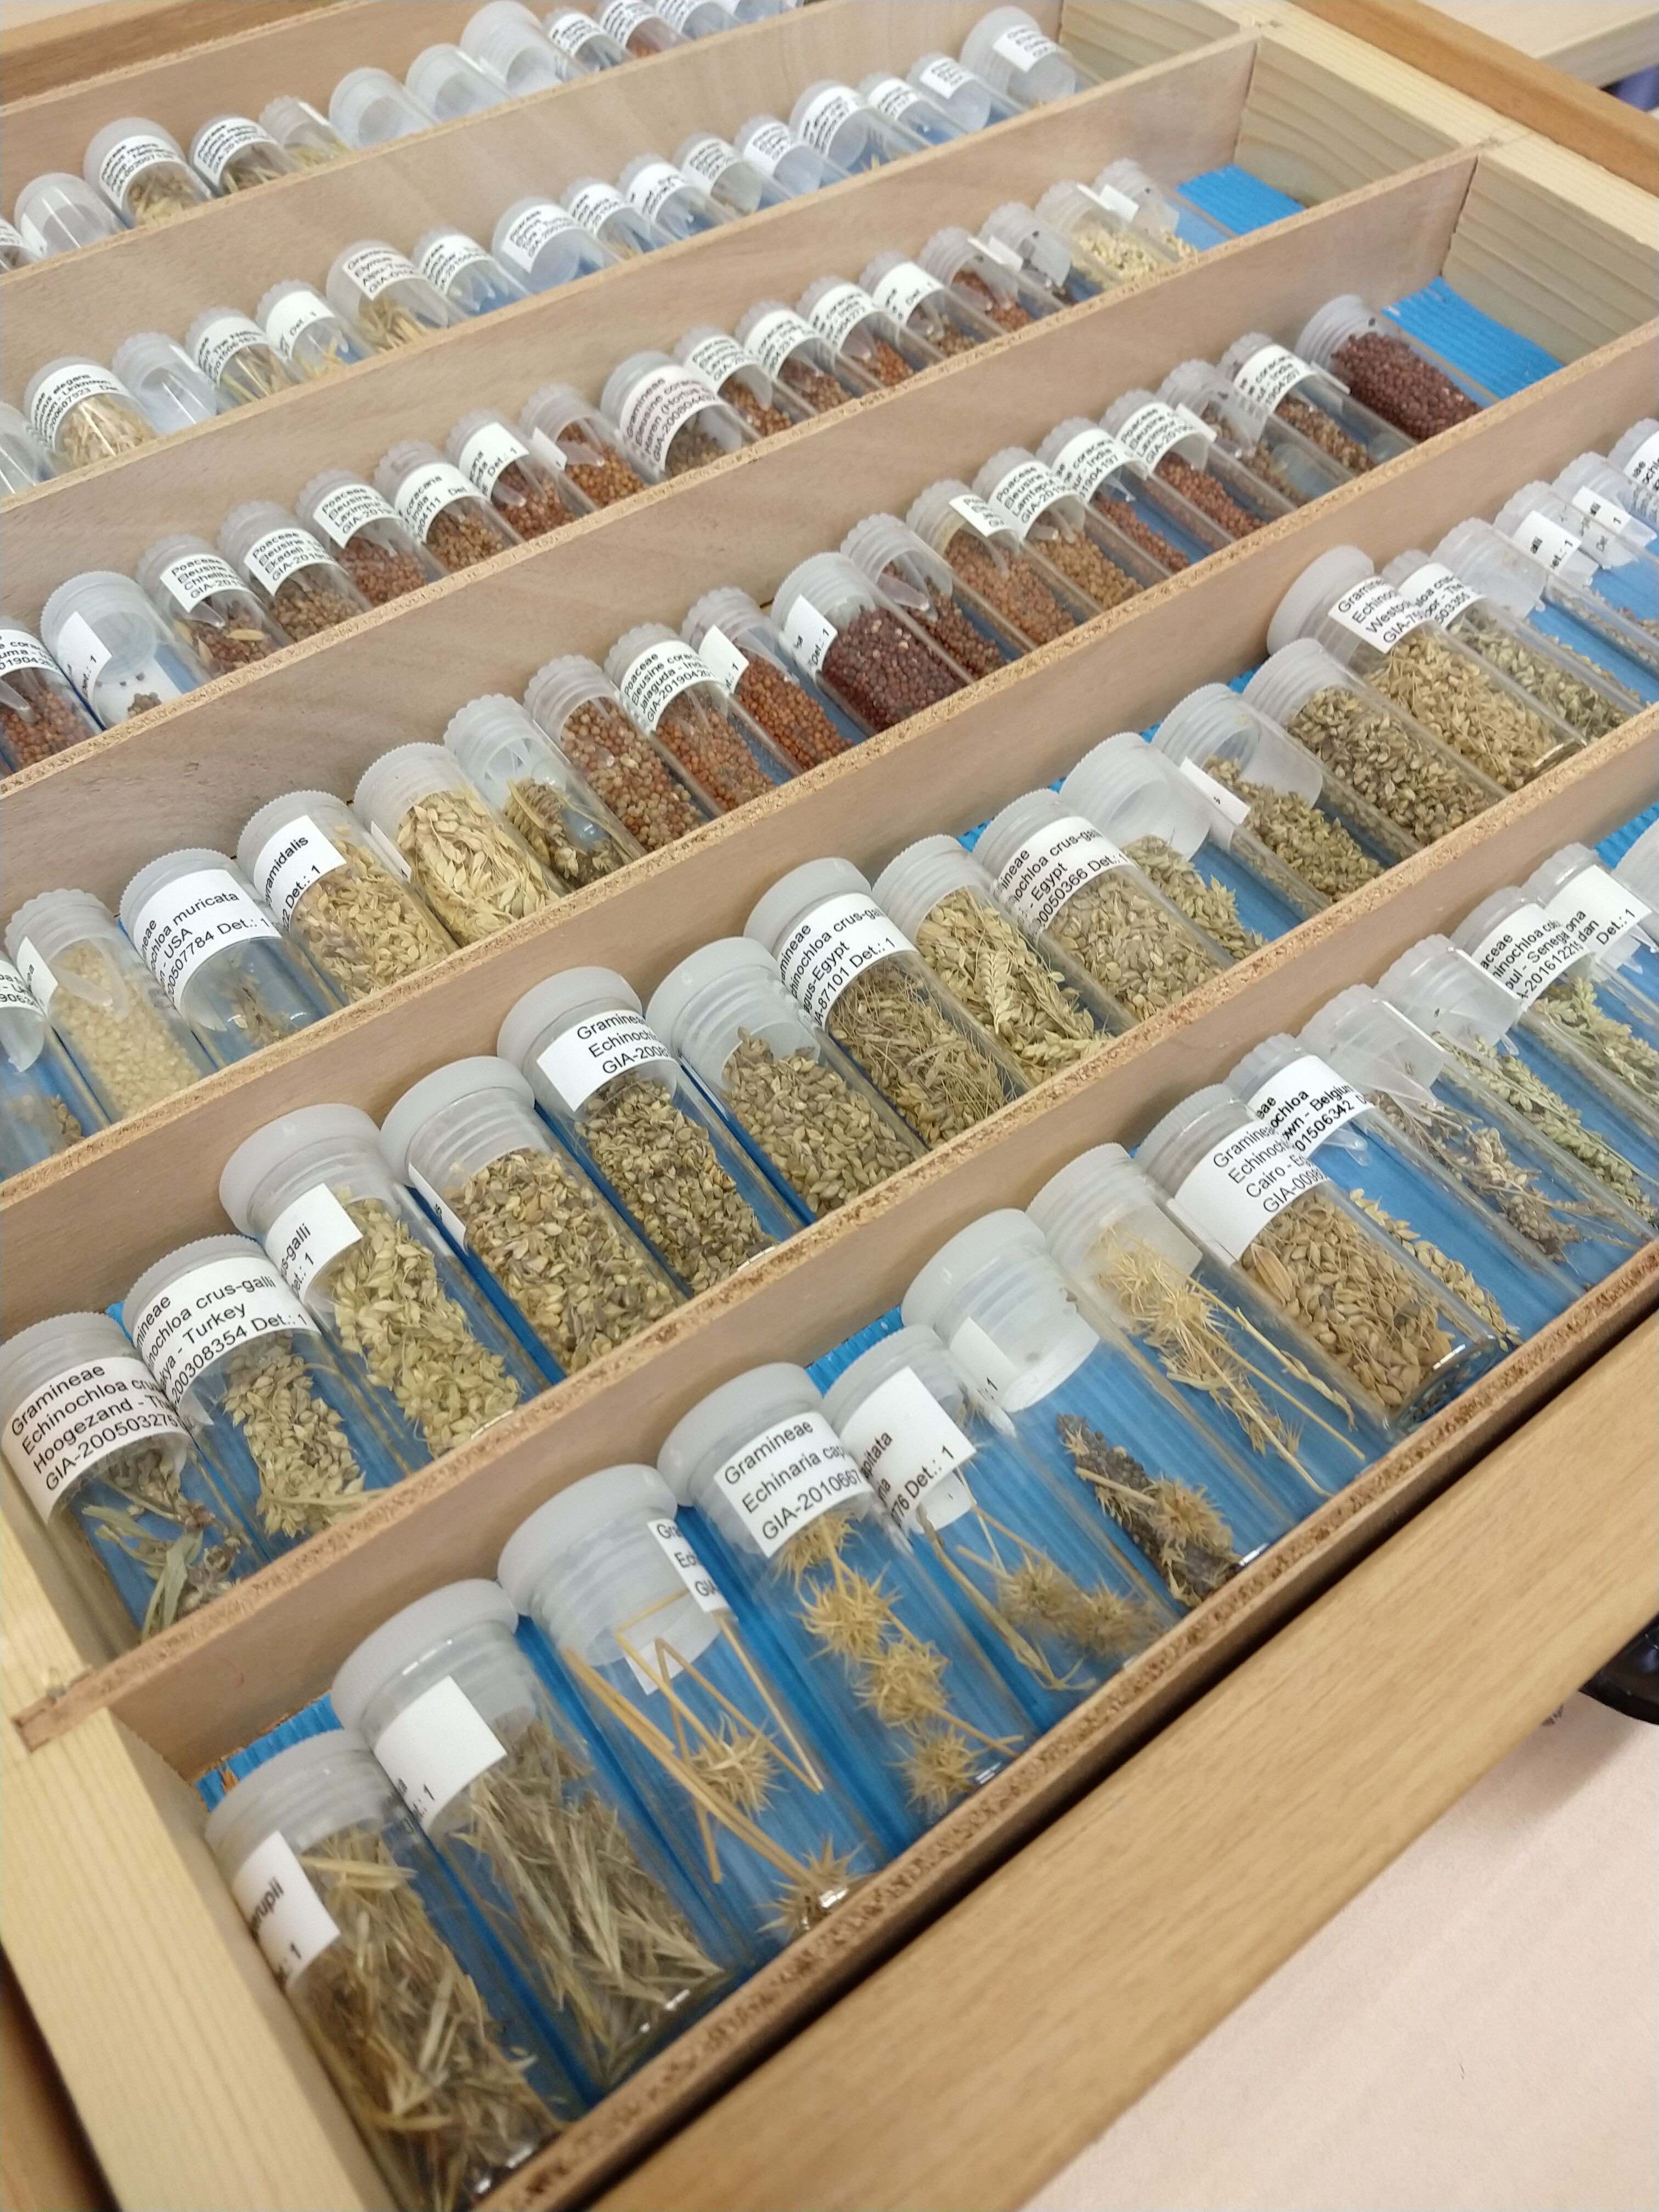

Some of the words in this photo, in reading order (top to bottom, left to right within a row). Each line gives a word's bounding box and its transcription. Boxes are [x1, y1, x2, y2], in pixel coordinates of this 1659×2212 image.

[822, 627, 830, 637] 1
[624, 653, 658, 698] Poaceae
[631, 663, 665, 706] Eleusine
[285, 876, 310, 909] Det.:
[311, 865, 321, 874] 1
[1031, 862, 1069, 902] Egypt
[172, 891, 240, 927] muricata
[216, 918, 258, 935] Det.:
[260, 917, 270, 928] 1
[1596, 915, 1627, 945] Det.:
[1625, 908, 1635, 918] 1
[164, 928, 193, 959] USA
[849, 941, 885, 969] Det.:
[885, 936, 896, 949] 1
[1246, 1165, 1285, 1198] Cairo
[304, 1252, 314, 1266] 1
[195, 1275, 276, 1310] crus-galli
[182, 1302, 246, 1345] Turkey
[251, 1313, 296, 1332] Det.:
[297, 1313, 307, 1325] 1
[12, 1364, 105, 1436] Gramineae
[986, 1376, 998, 1391] 1
[22, 1378, 129, 1455] Echinochloa
[32, 1401, 133, 1474] Hoogezand
[724, 1420, 814, 1485] Gramineae
[741, 1447, 822, 1515] Echinaria
[905, 1459, 943, 1499] Det.:
[942, 1444, 955, 1460] 1
[424, 1784, 435, 1801] 1
[290, 1943, 302, 1960] 1
